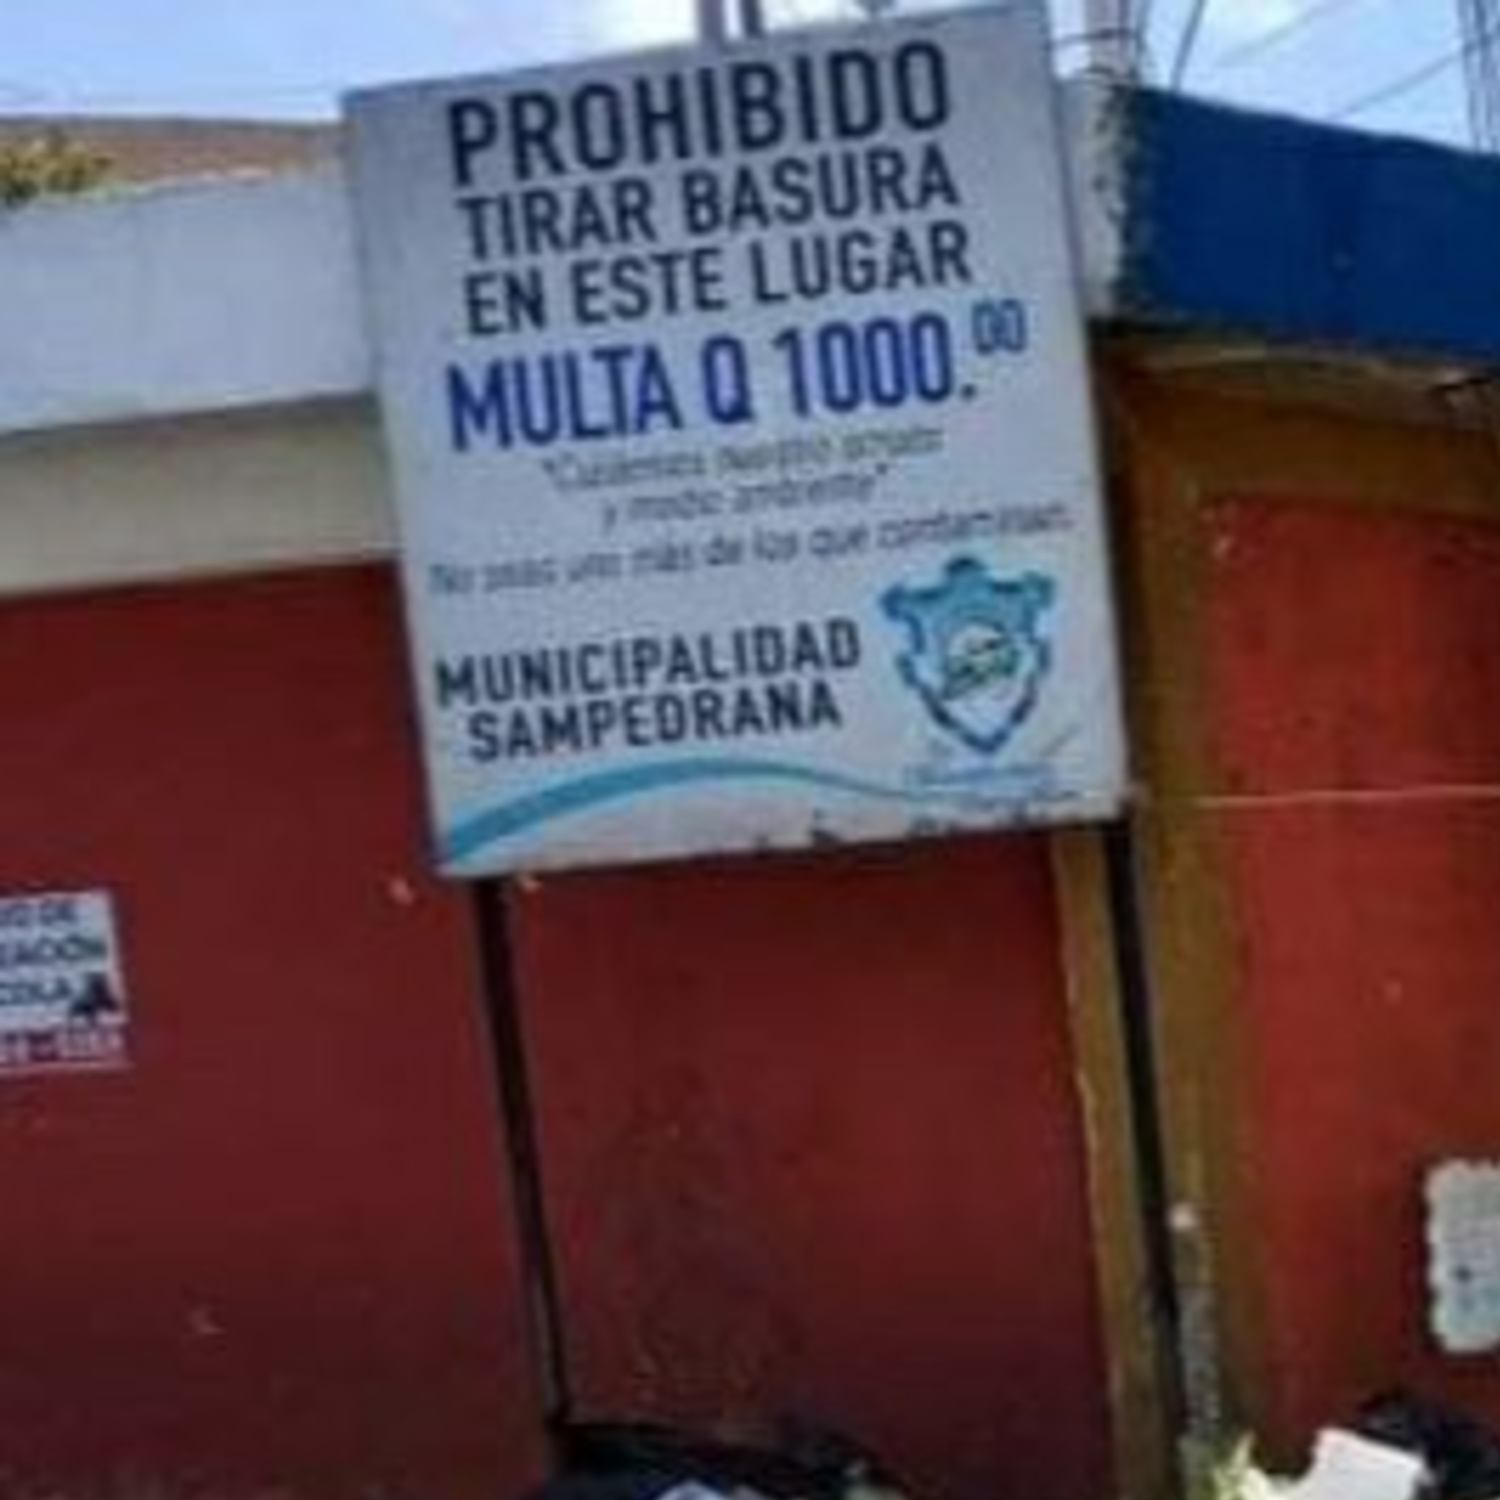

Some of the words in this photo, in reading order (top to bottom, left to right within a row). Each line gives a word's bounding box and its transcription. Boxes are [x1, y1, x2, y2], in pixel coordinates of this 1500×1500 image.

[449, 42, 949, 186] PROHIBIDO
[456, 180, 656, 262] TIRAR
[681, 144, 961, 235] BASURA
[465, 271, 547, 336] EN
[574, 247, 728, 324] ESTE
[751, 221, 973, 307] LUGAR
[449, 344, 684, 452] MULTA
[702, 337, 754, 425] Q
[436, 617, 860, 708] MUNICIPALIDAD
[467, 680, 842, 763] SAMPEDRANA
